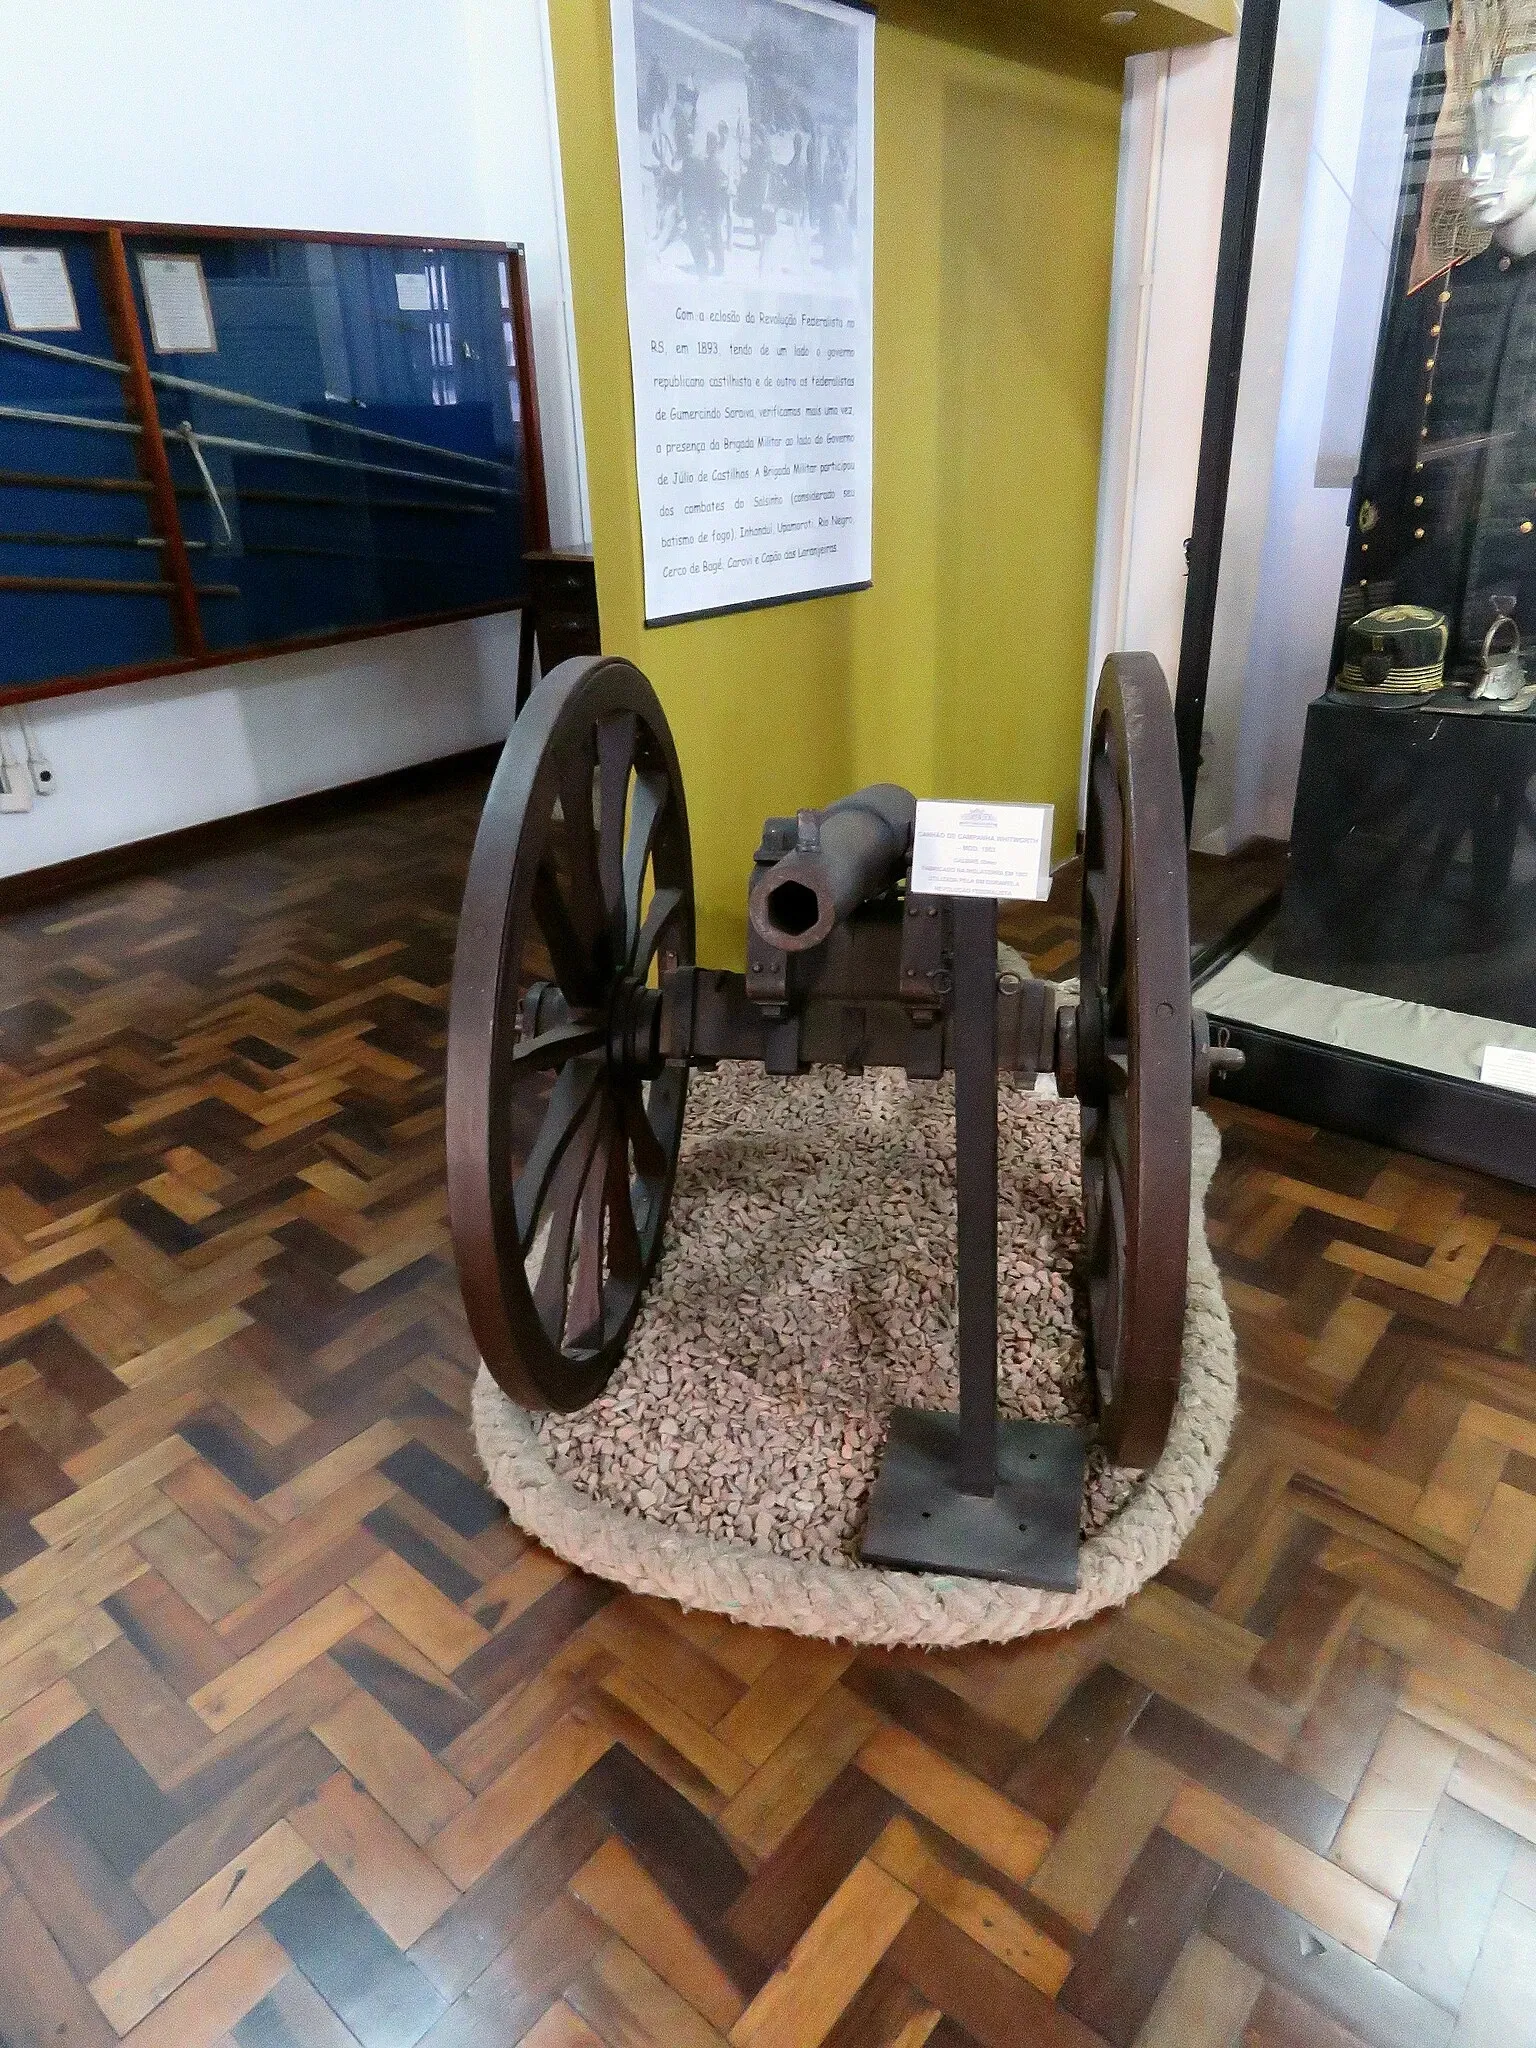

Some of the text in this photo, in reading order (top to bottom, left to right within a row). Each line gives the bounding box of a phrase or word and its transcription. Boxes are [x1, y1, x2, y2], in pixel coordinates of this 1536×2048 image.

[675, 307, 694, 320] Com
[710, 310, 740, 323] eclosão
[759, 312, 797, 328] Revolução
[801, 314, 843, 328] Federalista
[676, 344, 689, 354] em
[730, 344, 752, 355] tendo
[760, 345, 769, 356] de
[777, 347, 787, 356] um
[794, 344, 809, 356] lado
[816, 347, 820, 356] o
[827, 349, 855, 360] governo
[653, 376, 704, 390] republicano
[709, 376, 751, 387] castilhista
[755, 377, 760, 387] e
[764, 376, 773, 387] de
[776, 377, 796, 387] outro
[812, 376, 854, 387] federalistas
[655, 410, 667, 421] de
[670, 408, 721, 420] Gumercindo
[759, 404, 800, 417] verificamos
[805, 405, 821, 416] mais
[825, 407, 838, 416] uma
[666, 442, 705, 457] presença
[724, 438, 754, 452] Brigada
[757, 436, 782, 448] Militar
[785, 437, 793, 446] ao
[796, 434, 812, 446] lado
[826, 433, 855, 445] Governo
[657, 473, 668, 486] de
[672, 471, 694, 485] Júlio
[698, 471, 708, 482] de
[755, 468, 760, 478] A
[763, 465, 791, 480] Brigada
[793, 462, 816, 474] Militar
[820, 461, 855, 474] participou
[659, 504, 674, 517] dos
[684, 499, 725, 515] combates
[791, 489, 835, 505] (considerado
[843, 489, 855, 498] seu
[662, 534, 694, 548] batismo
[698, 532, 709, 543] de
[818, 518, 829, 528] Rio
[663, 566, 687, 578] Cerco
[690, 562, 700, 574] de
[755, 555, 759, 564] e
[761, 550, 782, 563] Capão
[785, 548, 796, 560] das
